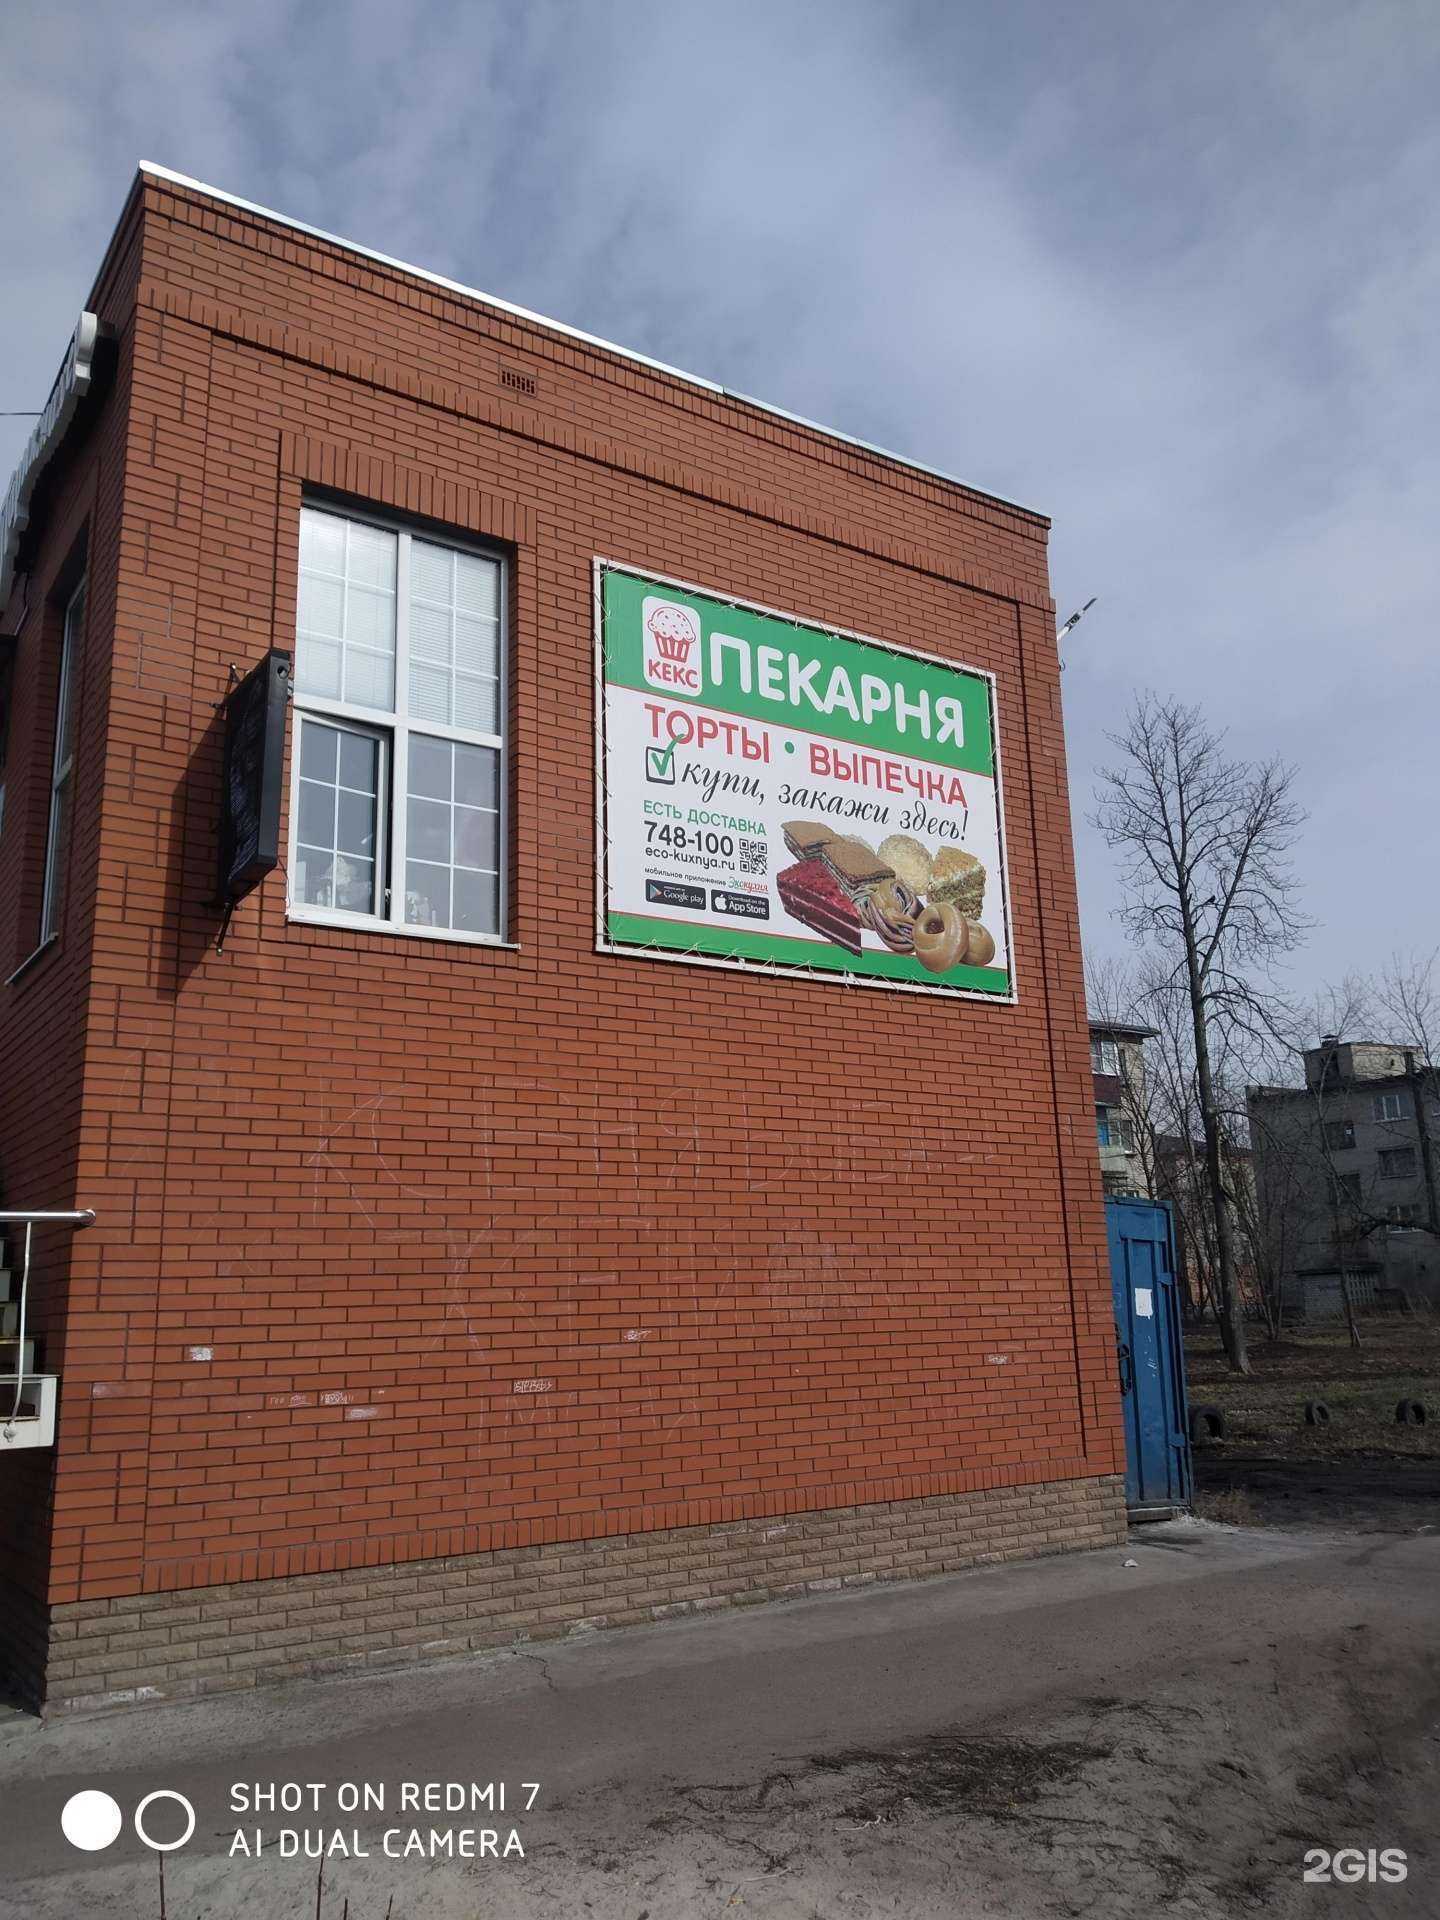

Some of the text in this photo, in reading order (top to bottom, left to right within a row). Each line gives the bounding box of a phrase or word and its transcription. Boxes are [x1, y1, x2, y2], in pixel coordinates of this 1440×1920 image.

[648, 658, 698, 690] КЕКС
[710, 632, 965, 748] ПЕКАРНЯ
[644, 703, 969, 809] ТОРТЫ ВЫПЕЧКА
[643, 800, 767, 836] ЕСТЬ ДОСТАВКА
[681, 762, 969, 841] купи, закажи здесь!
[644, 820, 734, 857] 748-100
[644, 867, 683, 879] мобильное
[645, 847, 736, 871] eco-kuxnya.ru
[663, 890, 704, 905] Google play
[729, 901, 766, 915] App Store
